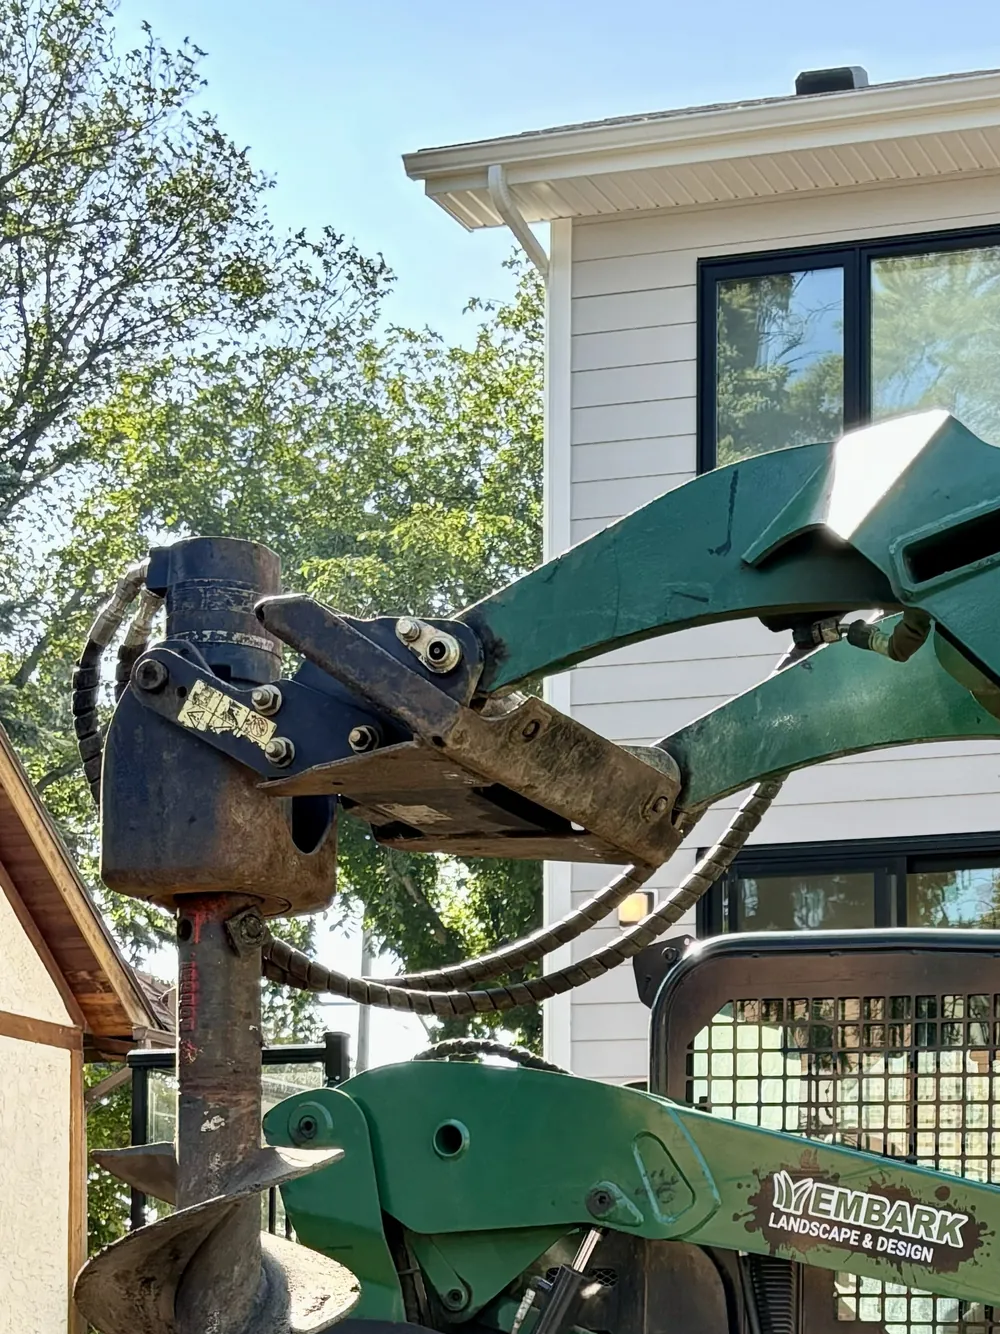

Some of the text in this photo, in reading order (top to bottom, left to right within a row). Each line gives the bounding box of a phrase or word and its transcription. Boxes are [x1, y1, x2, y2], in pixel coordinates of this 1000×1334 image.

[768, 1212, 934, 1263] LANDSCAPE & DESIGN
[808, 1182, 969, 1249] EMBARK
